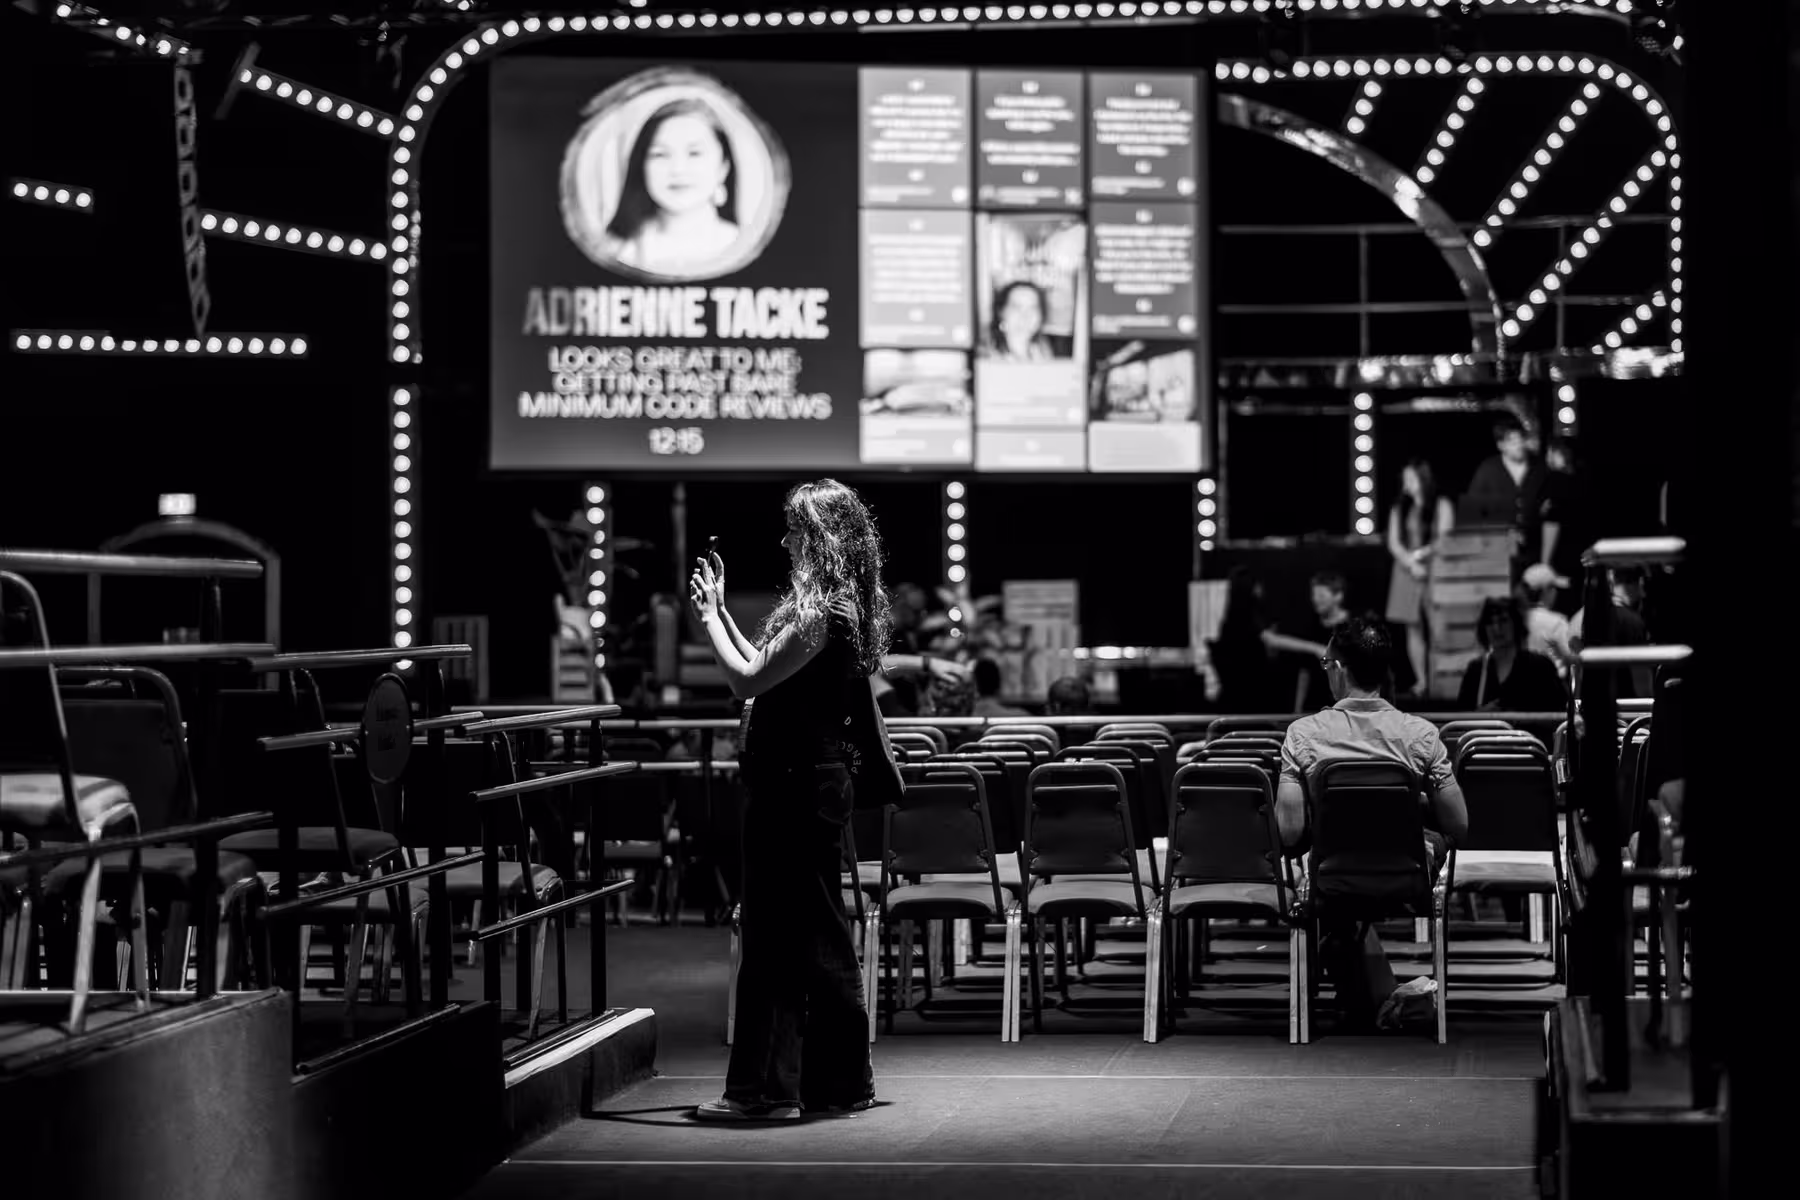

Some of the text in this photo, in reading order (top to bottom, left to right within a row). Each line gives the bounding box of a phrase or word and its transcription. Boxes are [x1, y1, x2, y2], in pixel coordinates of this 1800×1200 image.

[522, 286, 829, 339] ADRIENNE TACKE
[549, 346, 633, 373] LOOKS
[719, 347, 752, 373] TO
[519, 391, 643, 418] MINIMUM
[719, 393, 832, 419] REVIEWS
